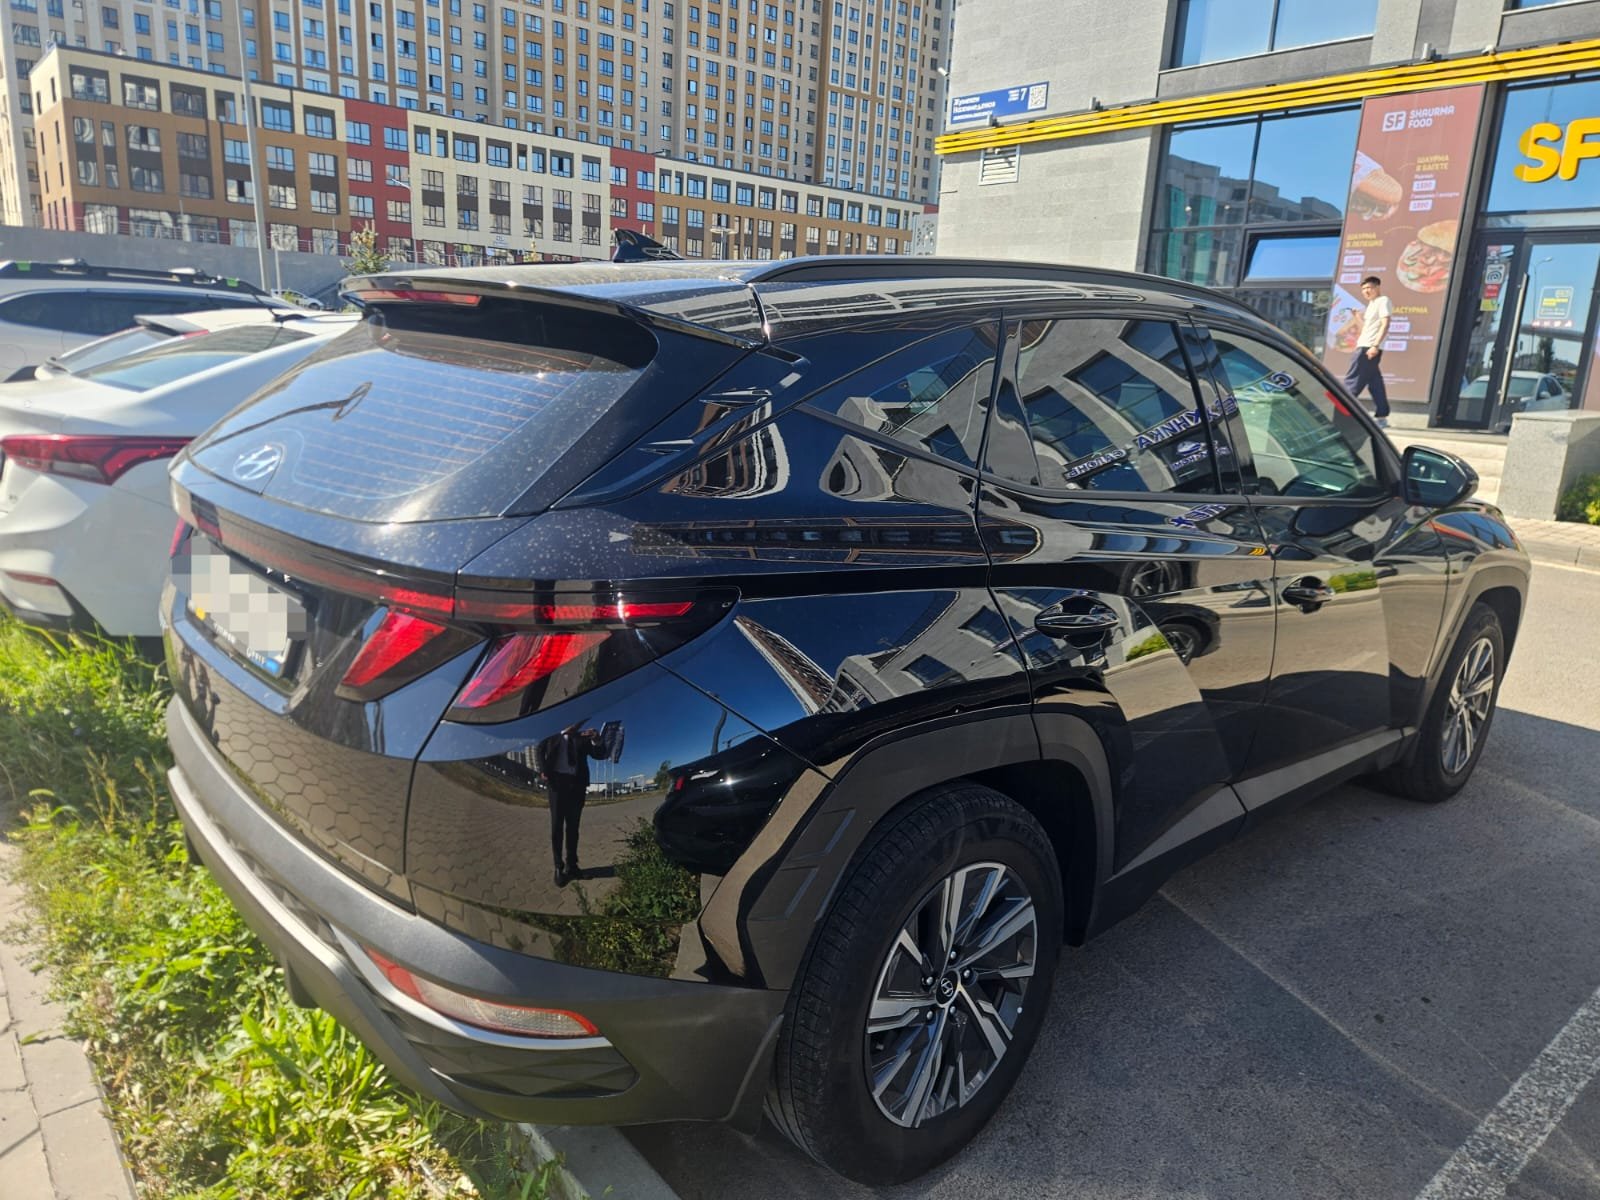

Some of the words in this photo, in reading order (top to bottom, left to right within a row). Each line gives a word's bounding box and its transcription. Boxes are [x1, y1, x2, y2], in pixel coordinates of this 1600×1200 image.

[1020, 87, 1028, 102] 7
[1409, 105, 1455, 119] SHAURMA
[1384, 112, 1405, 130] SF
[1408, 118, 1433, 129] FOOD
[1513, 117, 1600, 183] SF
